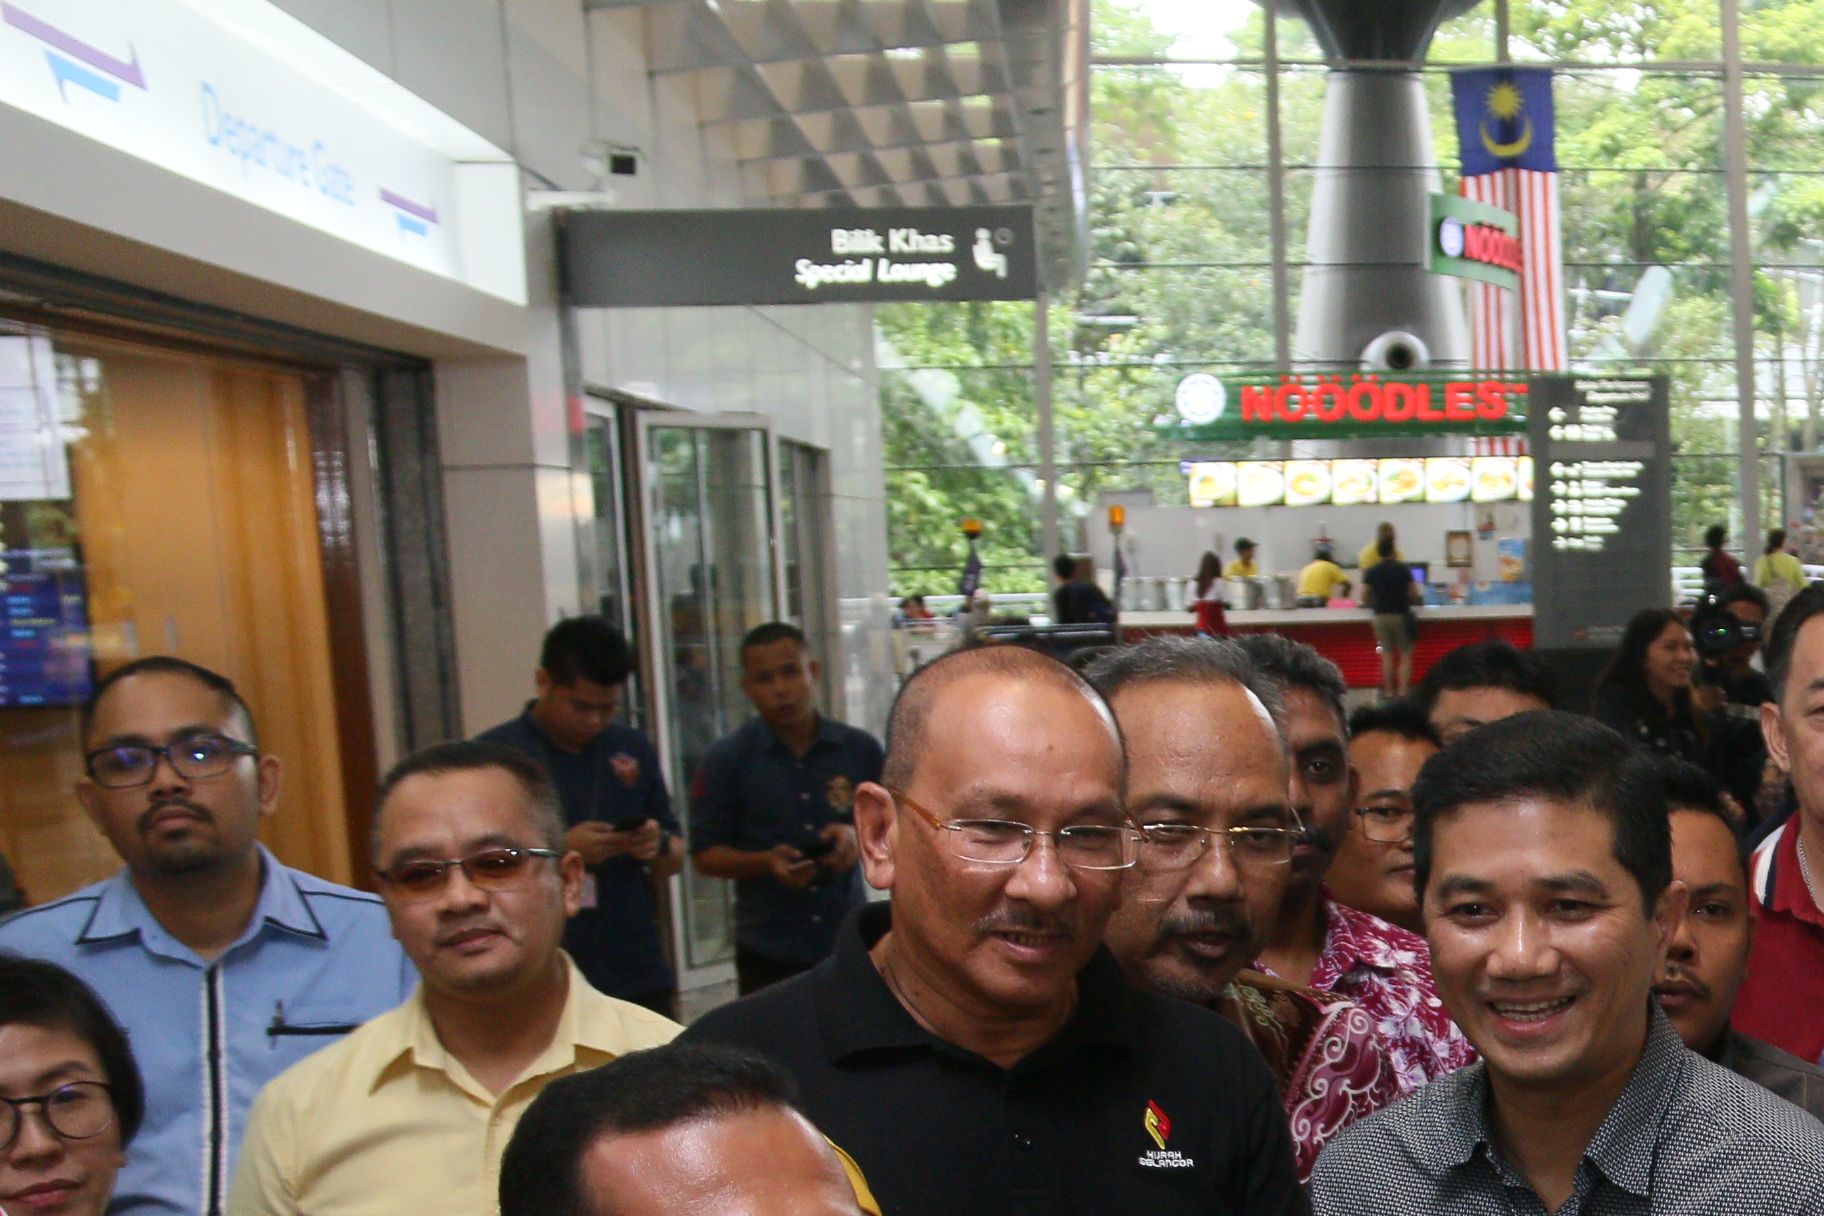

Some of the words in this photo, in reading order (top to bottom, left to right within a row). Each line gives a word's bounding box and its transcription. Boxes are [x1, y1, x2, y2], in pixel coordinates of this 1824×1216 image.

[888, 228, 955, 253] Khas
[794, 258, 873, 289] Special
[877, 258, 957, 288] Lounge
[1138, 1157, 1195, 1168] SELANGOR
